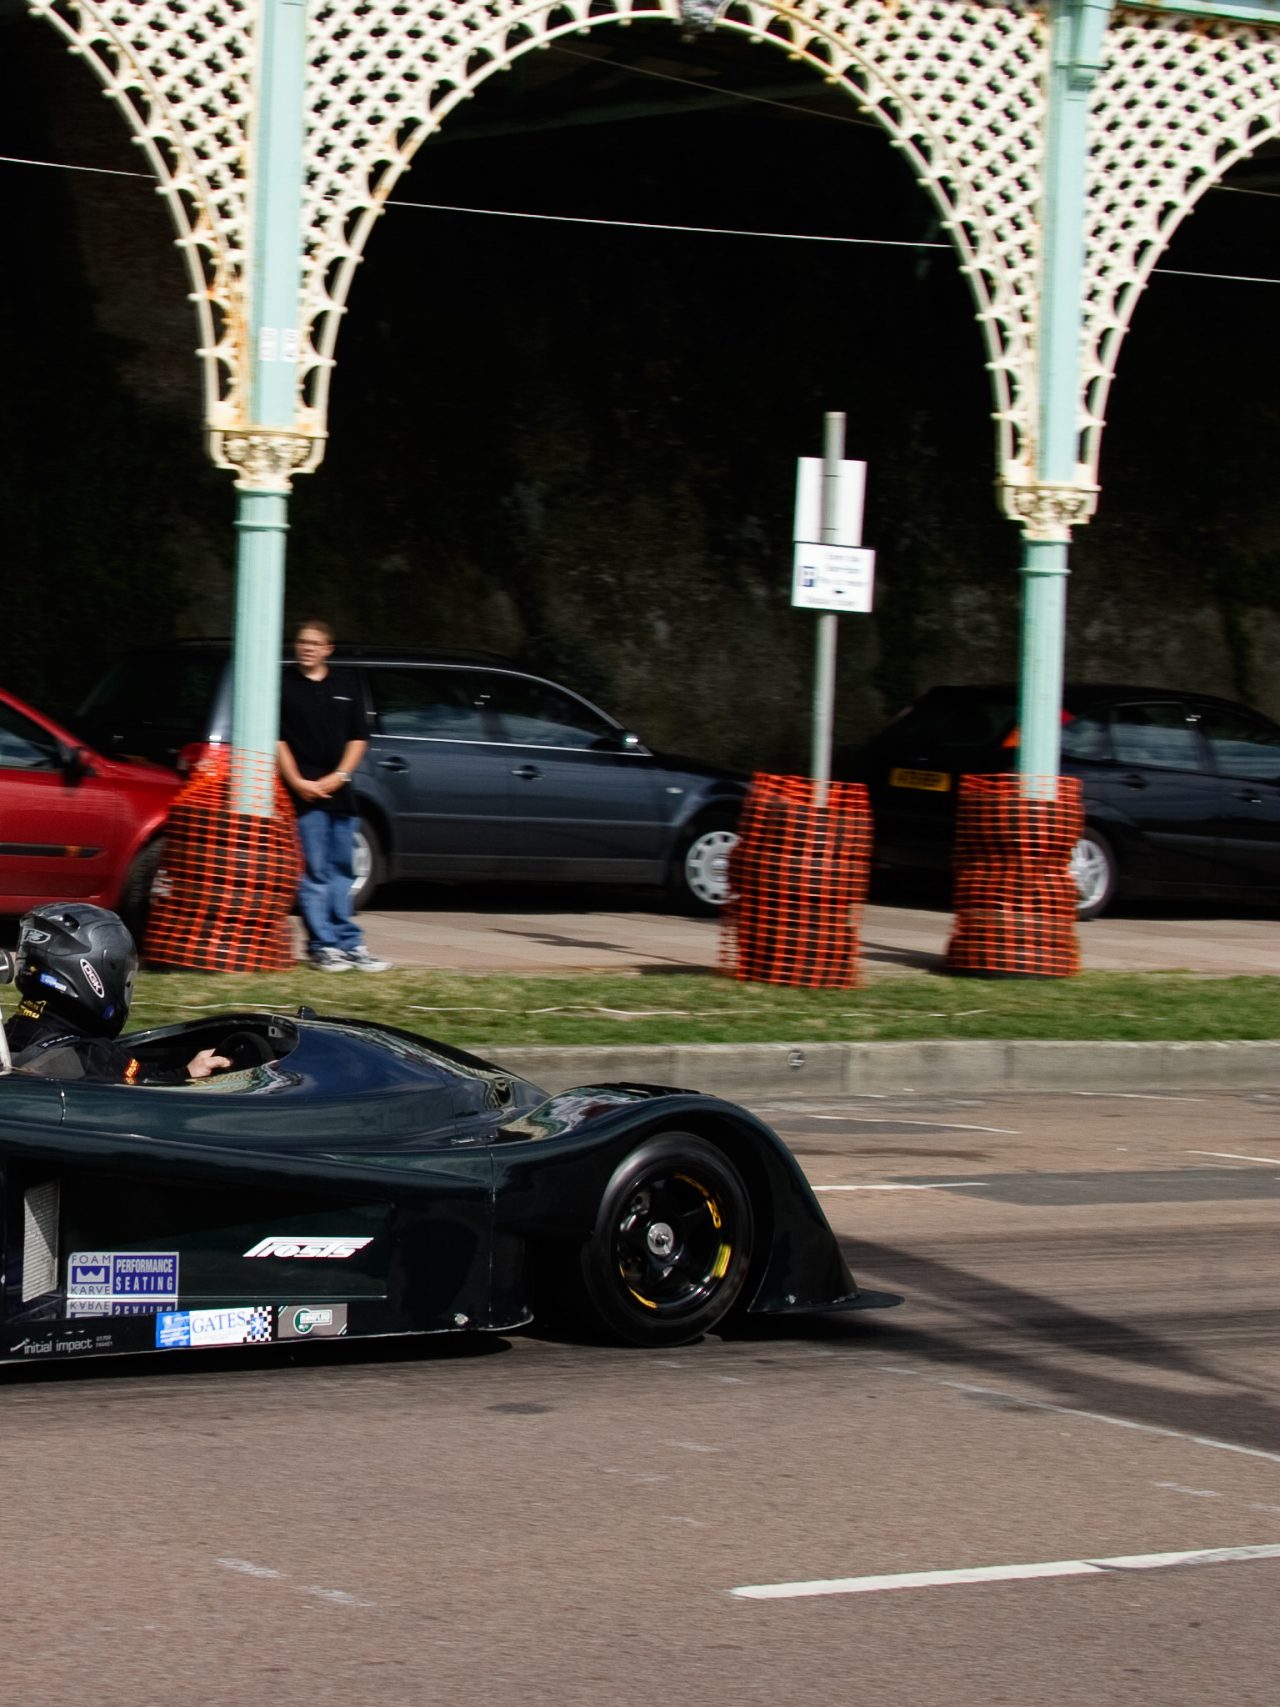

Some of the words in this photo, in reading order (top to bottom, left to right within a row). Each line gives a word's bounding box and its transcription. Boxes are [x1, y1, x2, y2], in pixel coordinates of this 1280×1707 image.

[71, 1255, 111, 1264] FOAM
[116, 1259, 173, 1273] PERFORMANCE
[70, 1286, 110, 1295] KARVE
[115, 1276, 173, 1291] SEATING
[192, 1311, 246, 1334] GATES
[24, 1340, 52, 1354] initial
[56, 1339, 93, 1353] impact
